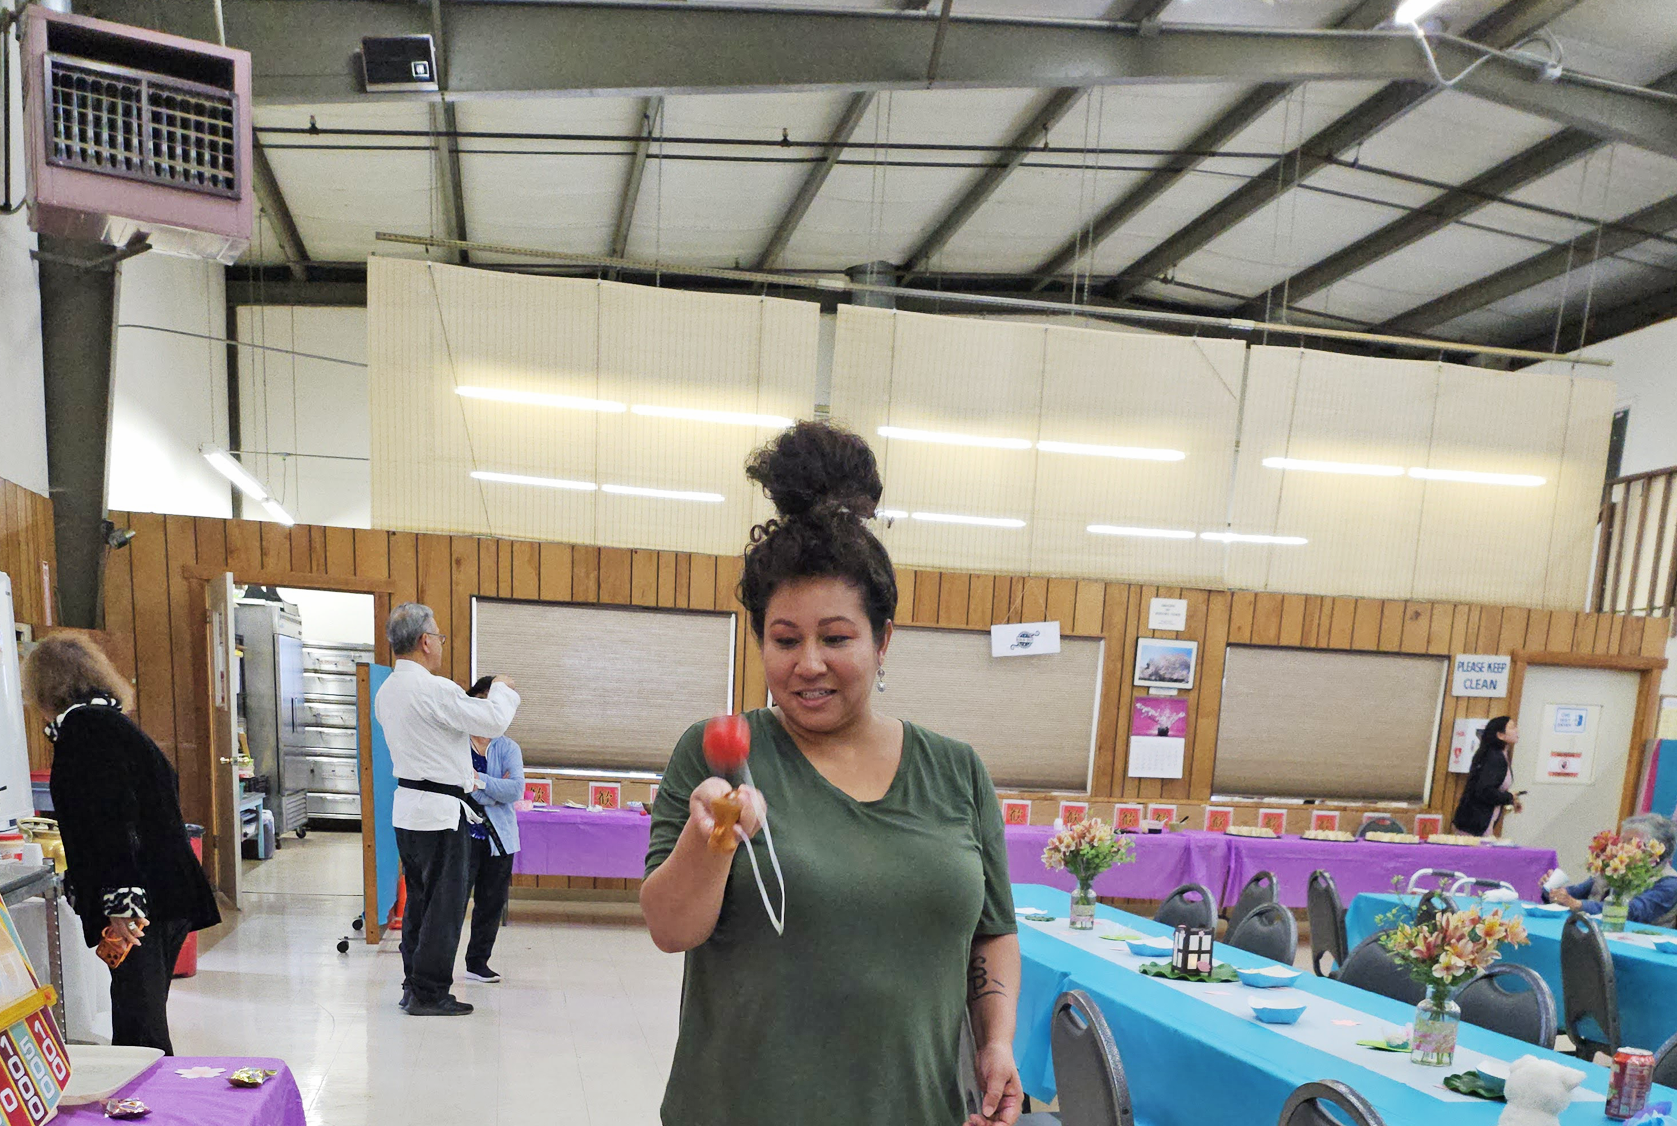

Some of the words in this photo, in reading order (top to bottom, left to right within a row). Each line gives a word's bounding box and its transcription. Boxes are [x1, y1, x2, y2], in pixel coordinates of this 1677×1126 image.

[1456, 661, 1485, 673] PLEASE
[1487, 662, 1507, 674] KEEP
[1463, 678, 1498, 690] CLEAN
[0, 1034, 45, 1121] 1000
[19, 1035, 55, 1099] 500
[34, 1020, 66, 1081] 100
